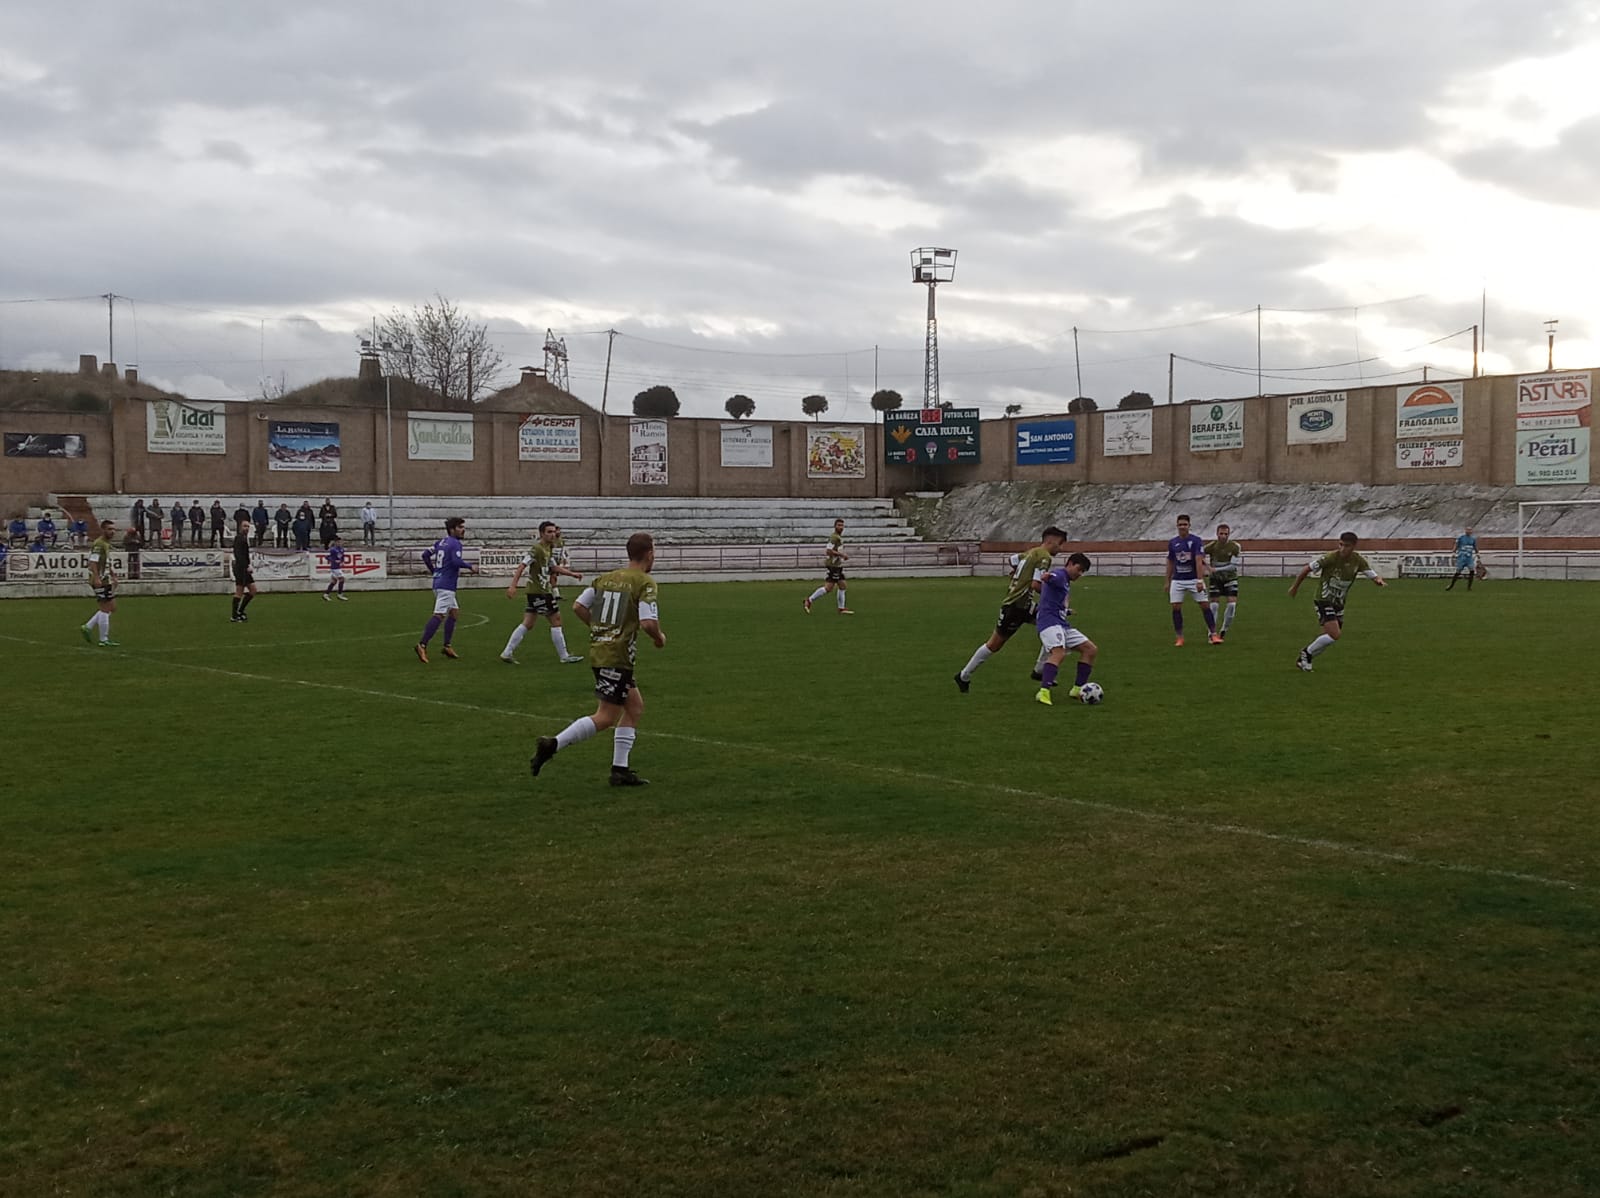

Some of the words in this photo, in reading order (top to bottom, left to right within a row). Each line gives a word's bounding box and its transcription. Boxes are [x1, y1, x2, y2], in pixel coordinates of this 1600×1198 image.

[1520, 382, 1588, 402] ASTURA
[915, 428, 938, 436] CAJA
[940, 426, 973, 435] RURAL
[1192, 423, 1227, 433] BERAFER,
[1228, 421, 1241, 431] S.L.
[1044, 432, 1073, 442] ANTONIO
[1528, 437, 1576, 457] Peral
[169, 555, 198, 567] Hoy
[601, 591, 621, 625] 11
